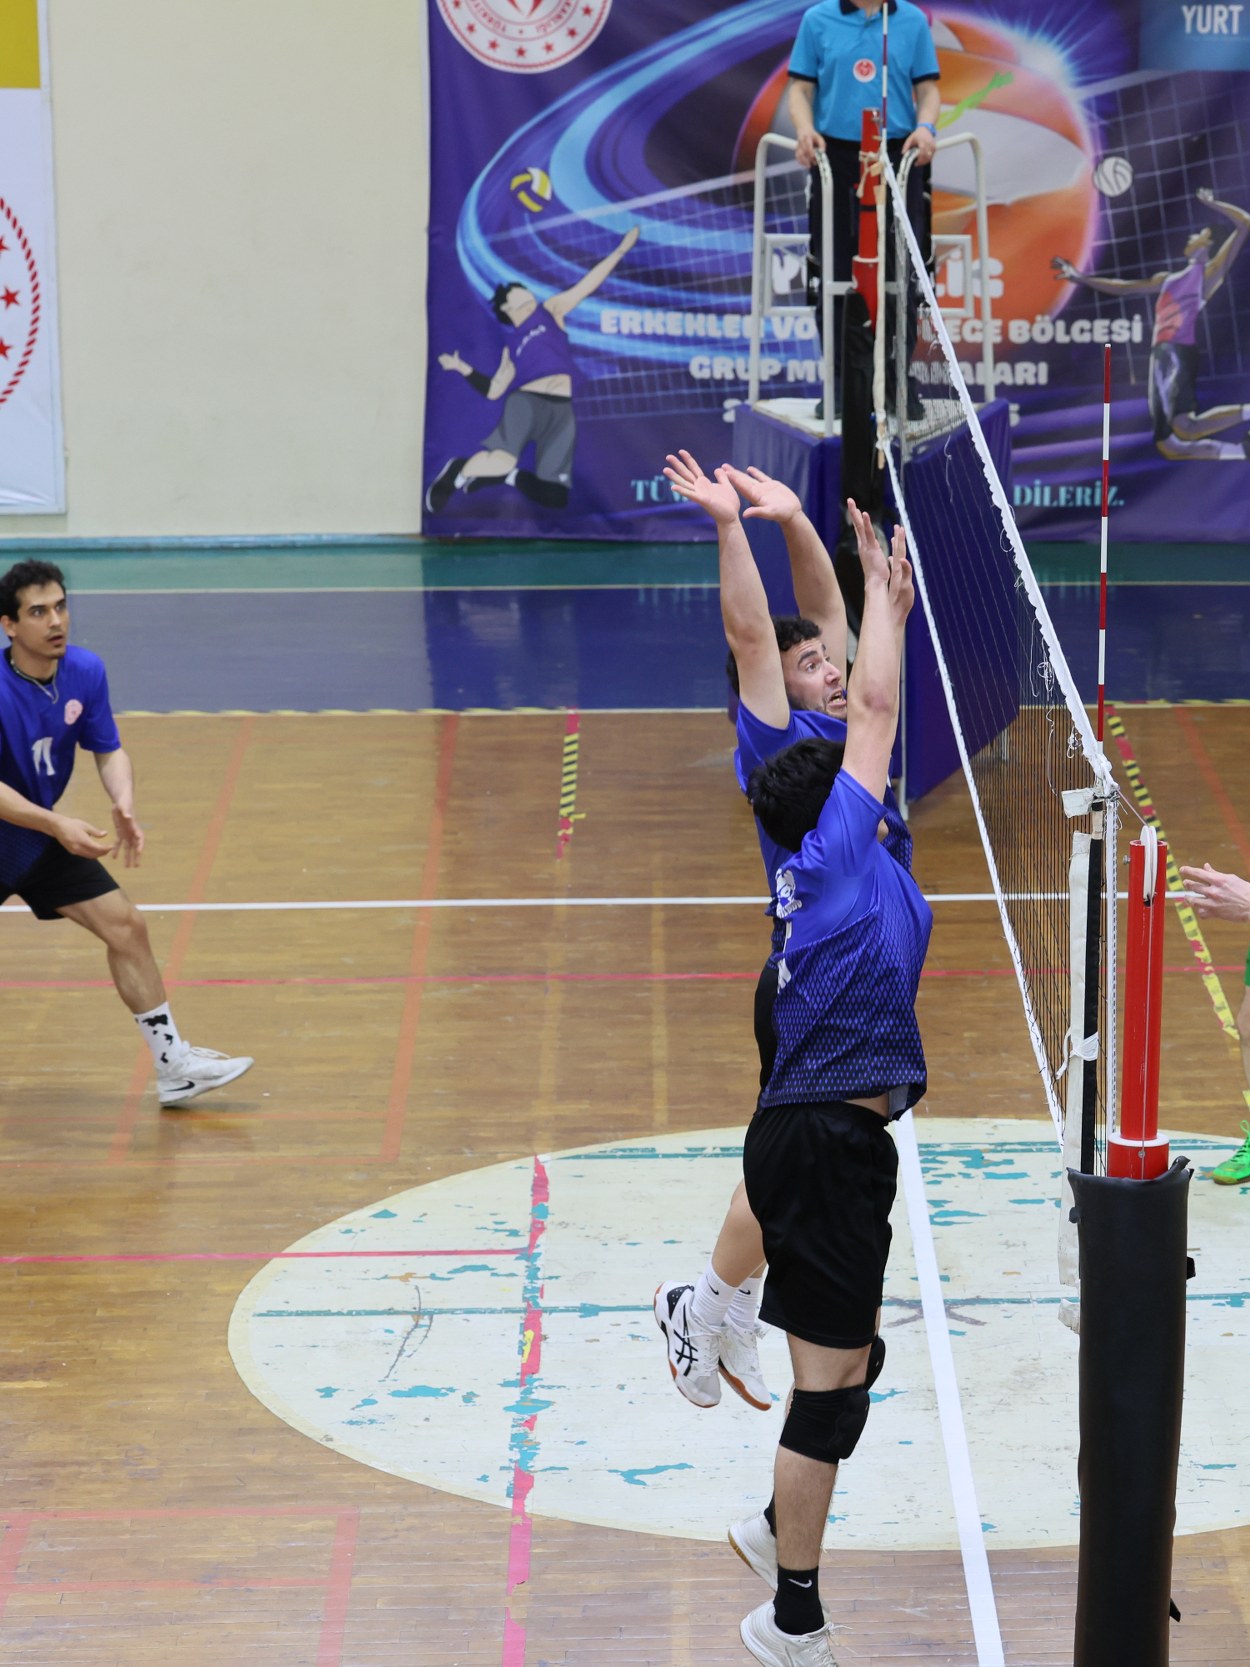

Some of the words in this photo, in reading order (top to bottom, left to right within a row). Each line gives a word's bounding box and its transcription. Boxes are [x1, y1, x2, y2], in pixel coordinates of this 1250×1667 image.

[1182, 4, 1244, 35] YURT
[1008, 314, 1142, 343] BÖLGESİ
[1013, 480, 1125, 507] DİLERİZ.
